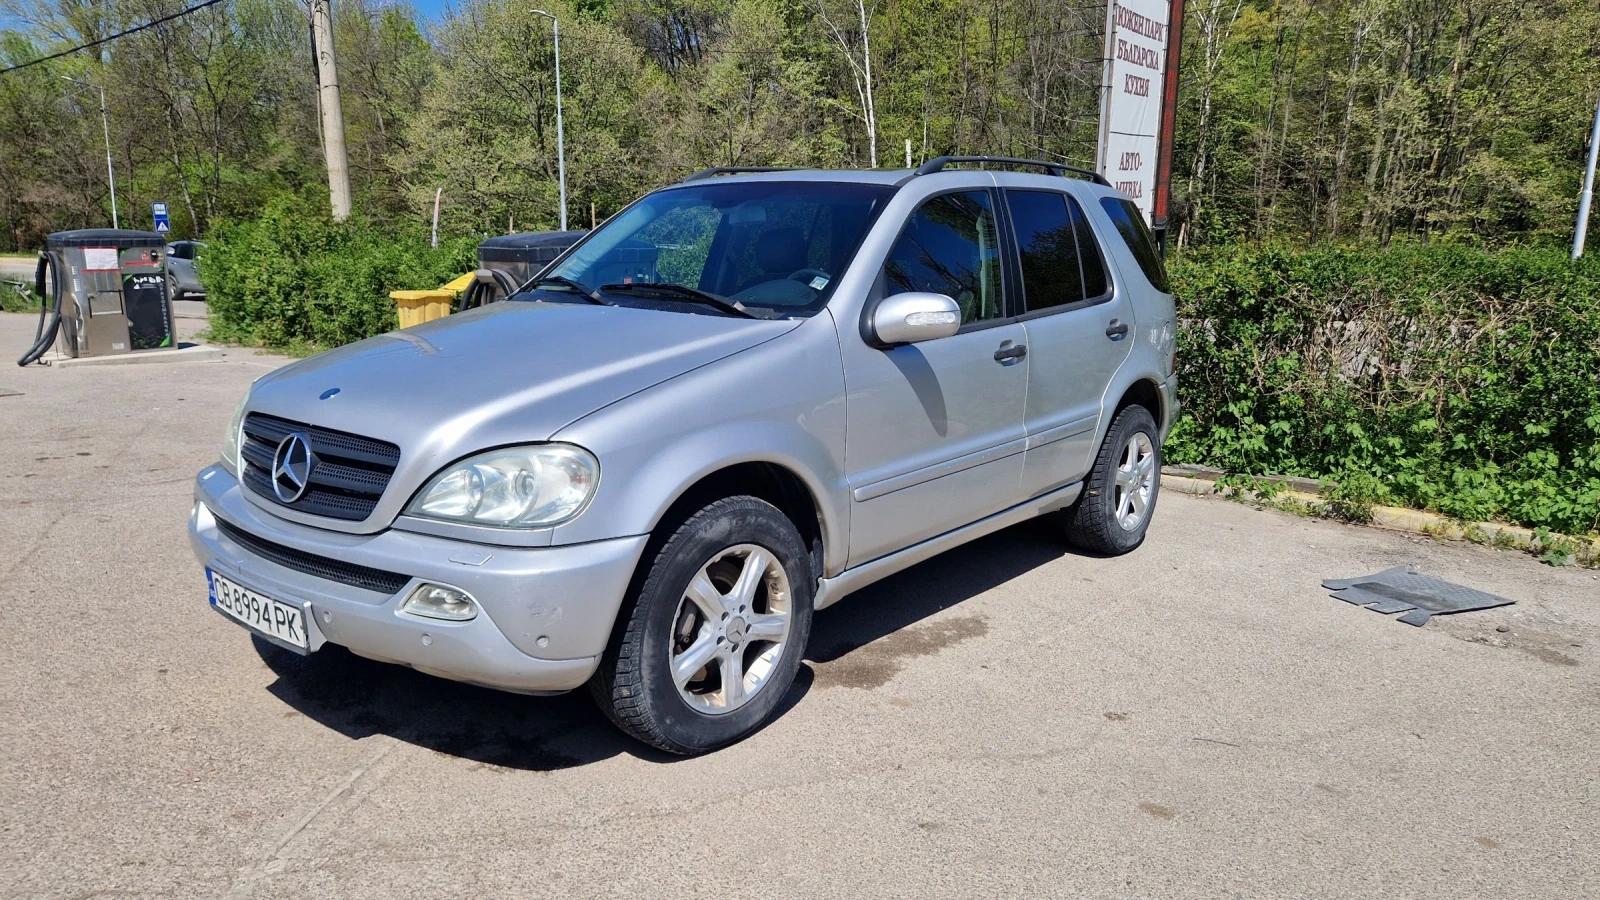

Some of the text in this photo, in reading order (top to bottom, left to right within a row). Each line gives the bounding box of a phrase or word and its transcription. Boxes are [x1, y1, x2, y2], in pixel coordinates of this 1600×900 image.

[1117, 5, 1163, 42] ЮЖЕН ПАРК
[1117, 39, 1159, 70] БЪЛГАРСКА
[1124, 73, 1150, 97] КУХНЯ
[1119, 152, 1142, 171] АВТО-
